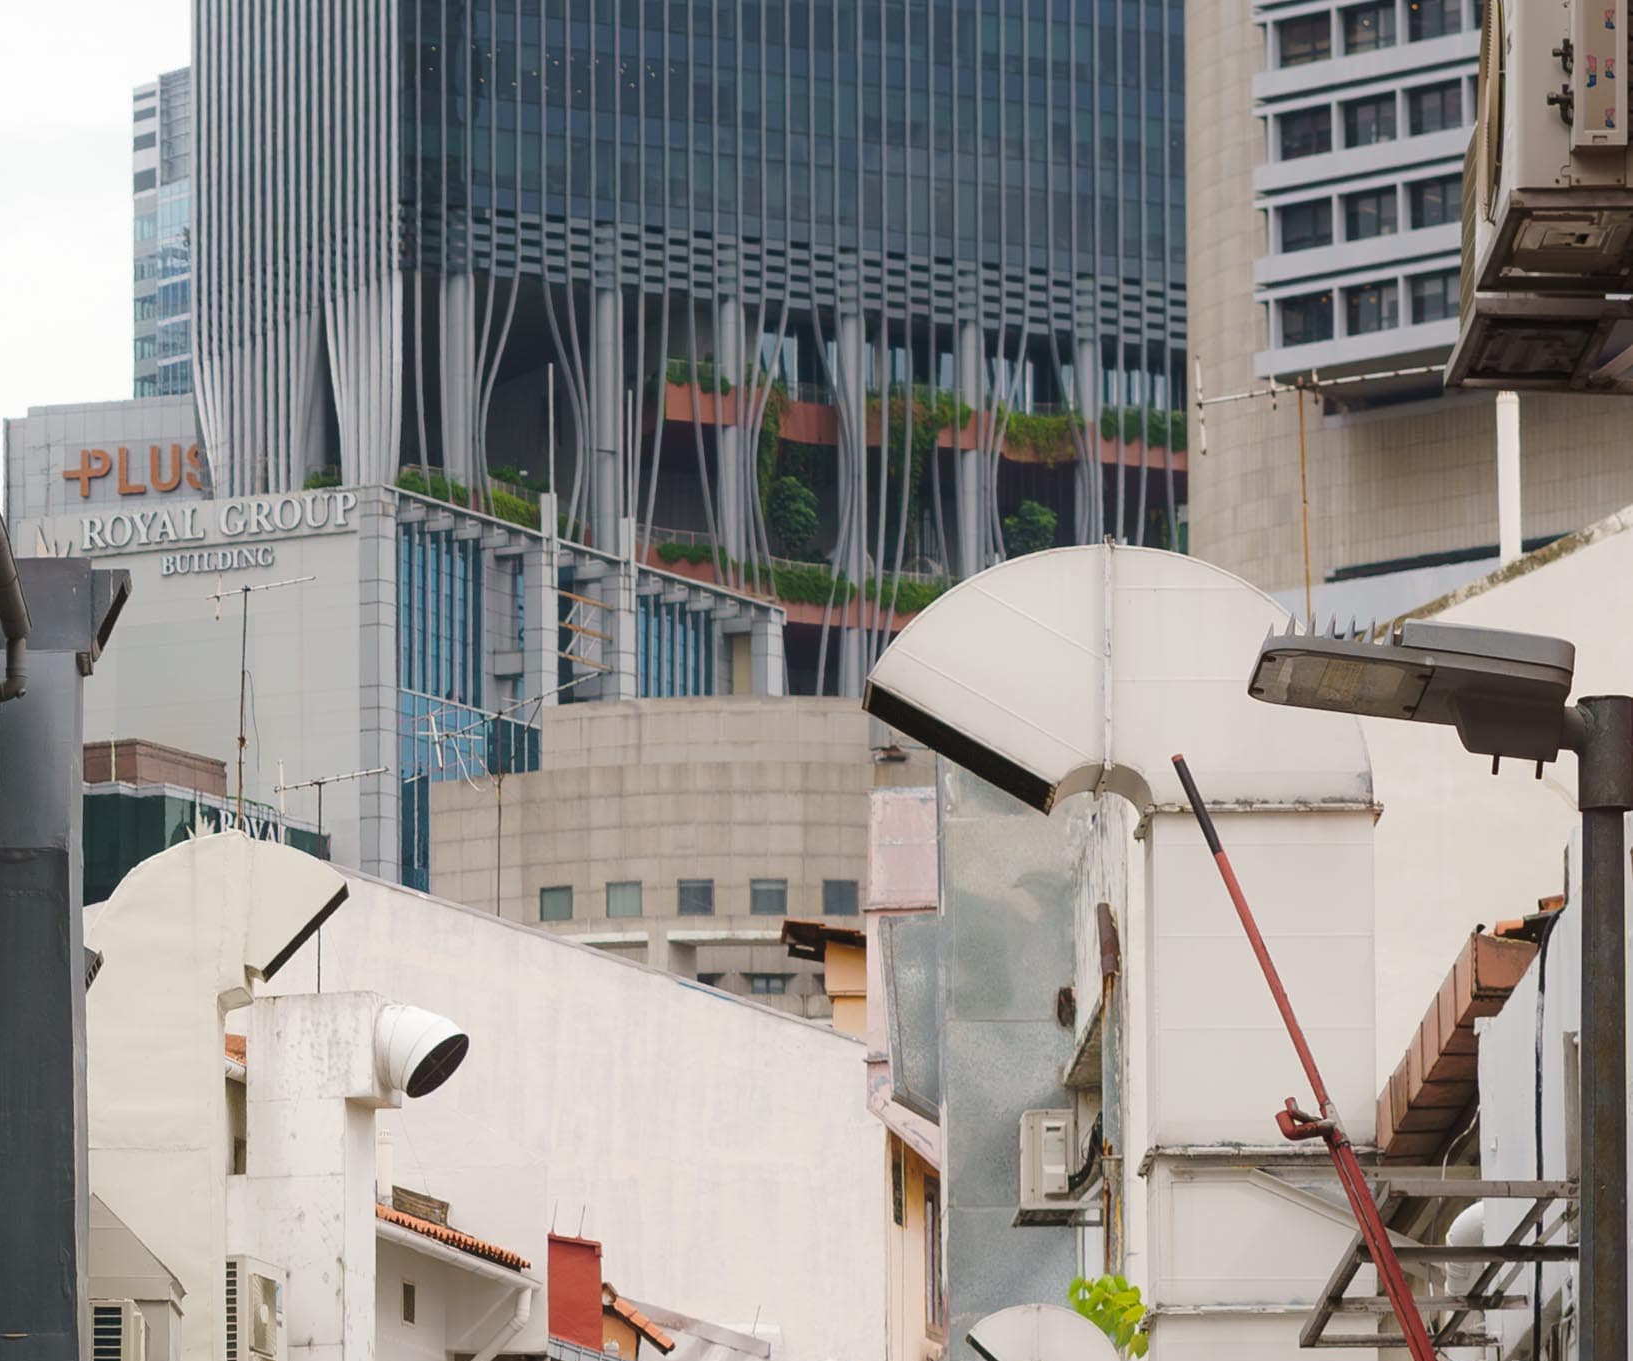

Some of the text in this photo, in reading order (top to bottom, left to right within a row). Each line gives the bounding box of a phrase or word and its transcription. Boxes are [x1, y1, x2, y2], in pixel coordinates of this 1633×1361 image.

[80, 491, 358, 551] ROYAL GROUP
[161, 545, 275, 577] BUILDING
